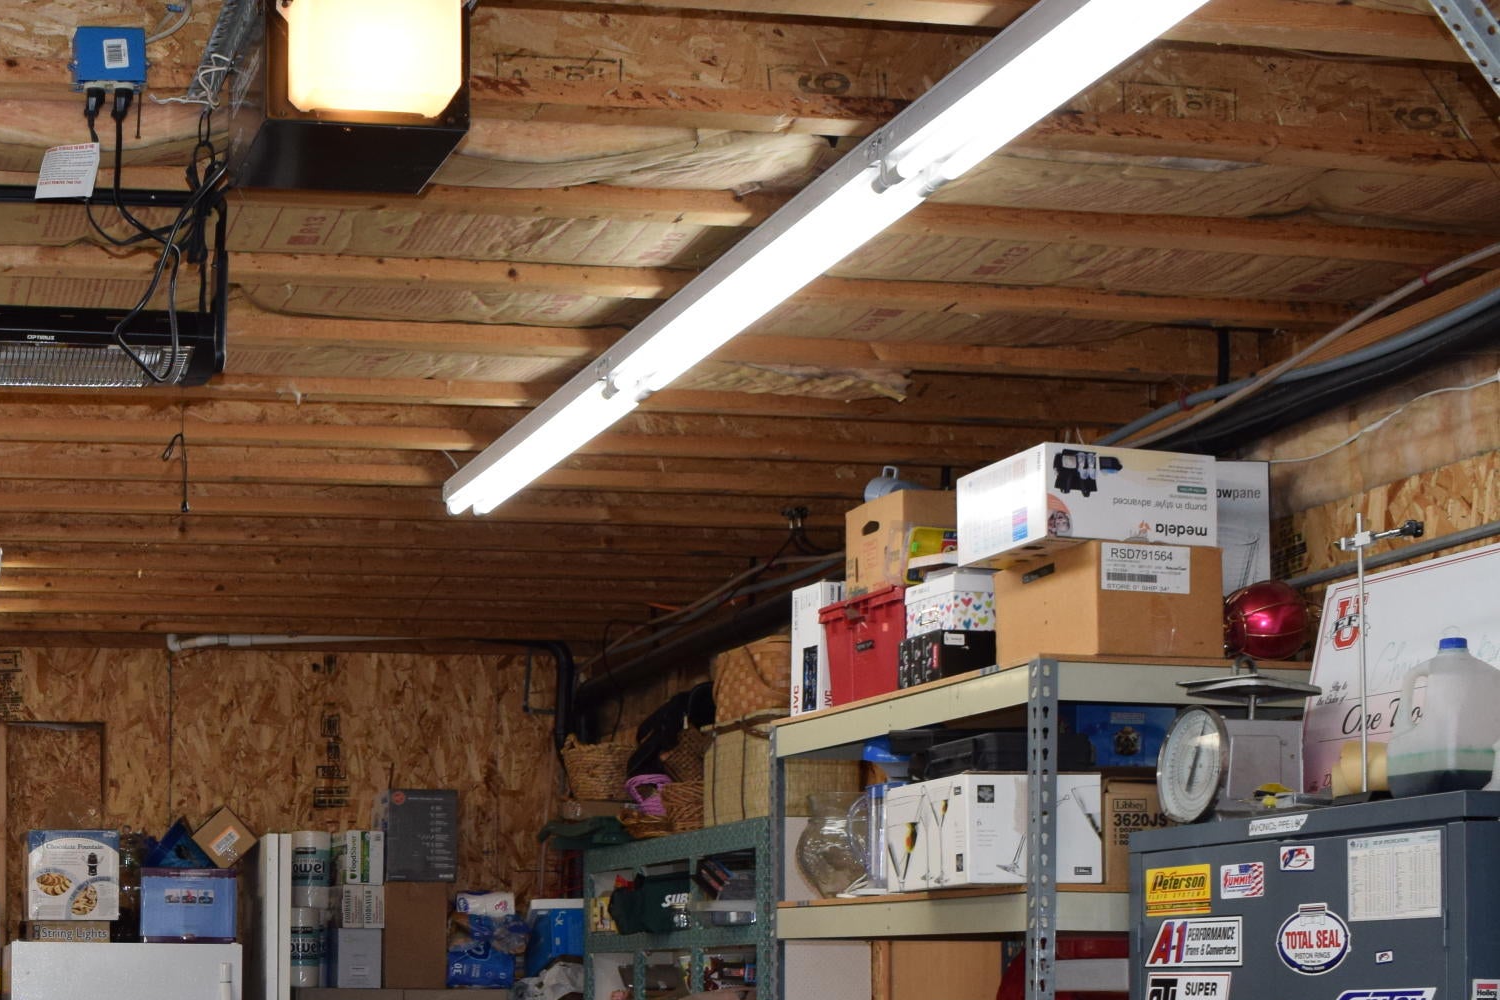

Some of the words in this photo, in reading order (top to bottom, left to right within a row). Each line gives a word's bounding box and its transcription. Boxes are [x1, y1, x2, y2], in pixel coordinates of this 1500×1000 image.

[1112, 496, 1152, 508] advanced
[1185, 502, 1208, 512] pump
[1155, 522, 1208, 537] medela
[1111, 548, 1173, 562] RSD791564
[1115, 799, 1145, 812] Libbey
[1113, 813, 1168, 828] 3620JS
[290, 861, 326, 874] owel
[1152, 871, 1206, 892] Peterson
[1223, 871, 1252, 888] SUMMIT
[41, 926, 73, 941] String
[76, 926, 108, 940] Lights
[1285, 930, 1313, 950] TOTAL
[1316, 929, 1341, 948] SEAL
[1150, 920, 1187, 964] A-1
[1187, 925, 1236, 941] PERFORMANCE
[1185, 945, 1199, 956] Trans
[1206, 944, 1237, 956] Converters
[1294, 952, 1314, 960] PISTON
[1315, 952, 1331, 960] RINGS
[1184, 982, 1217, 996] SUPER
